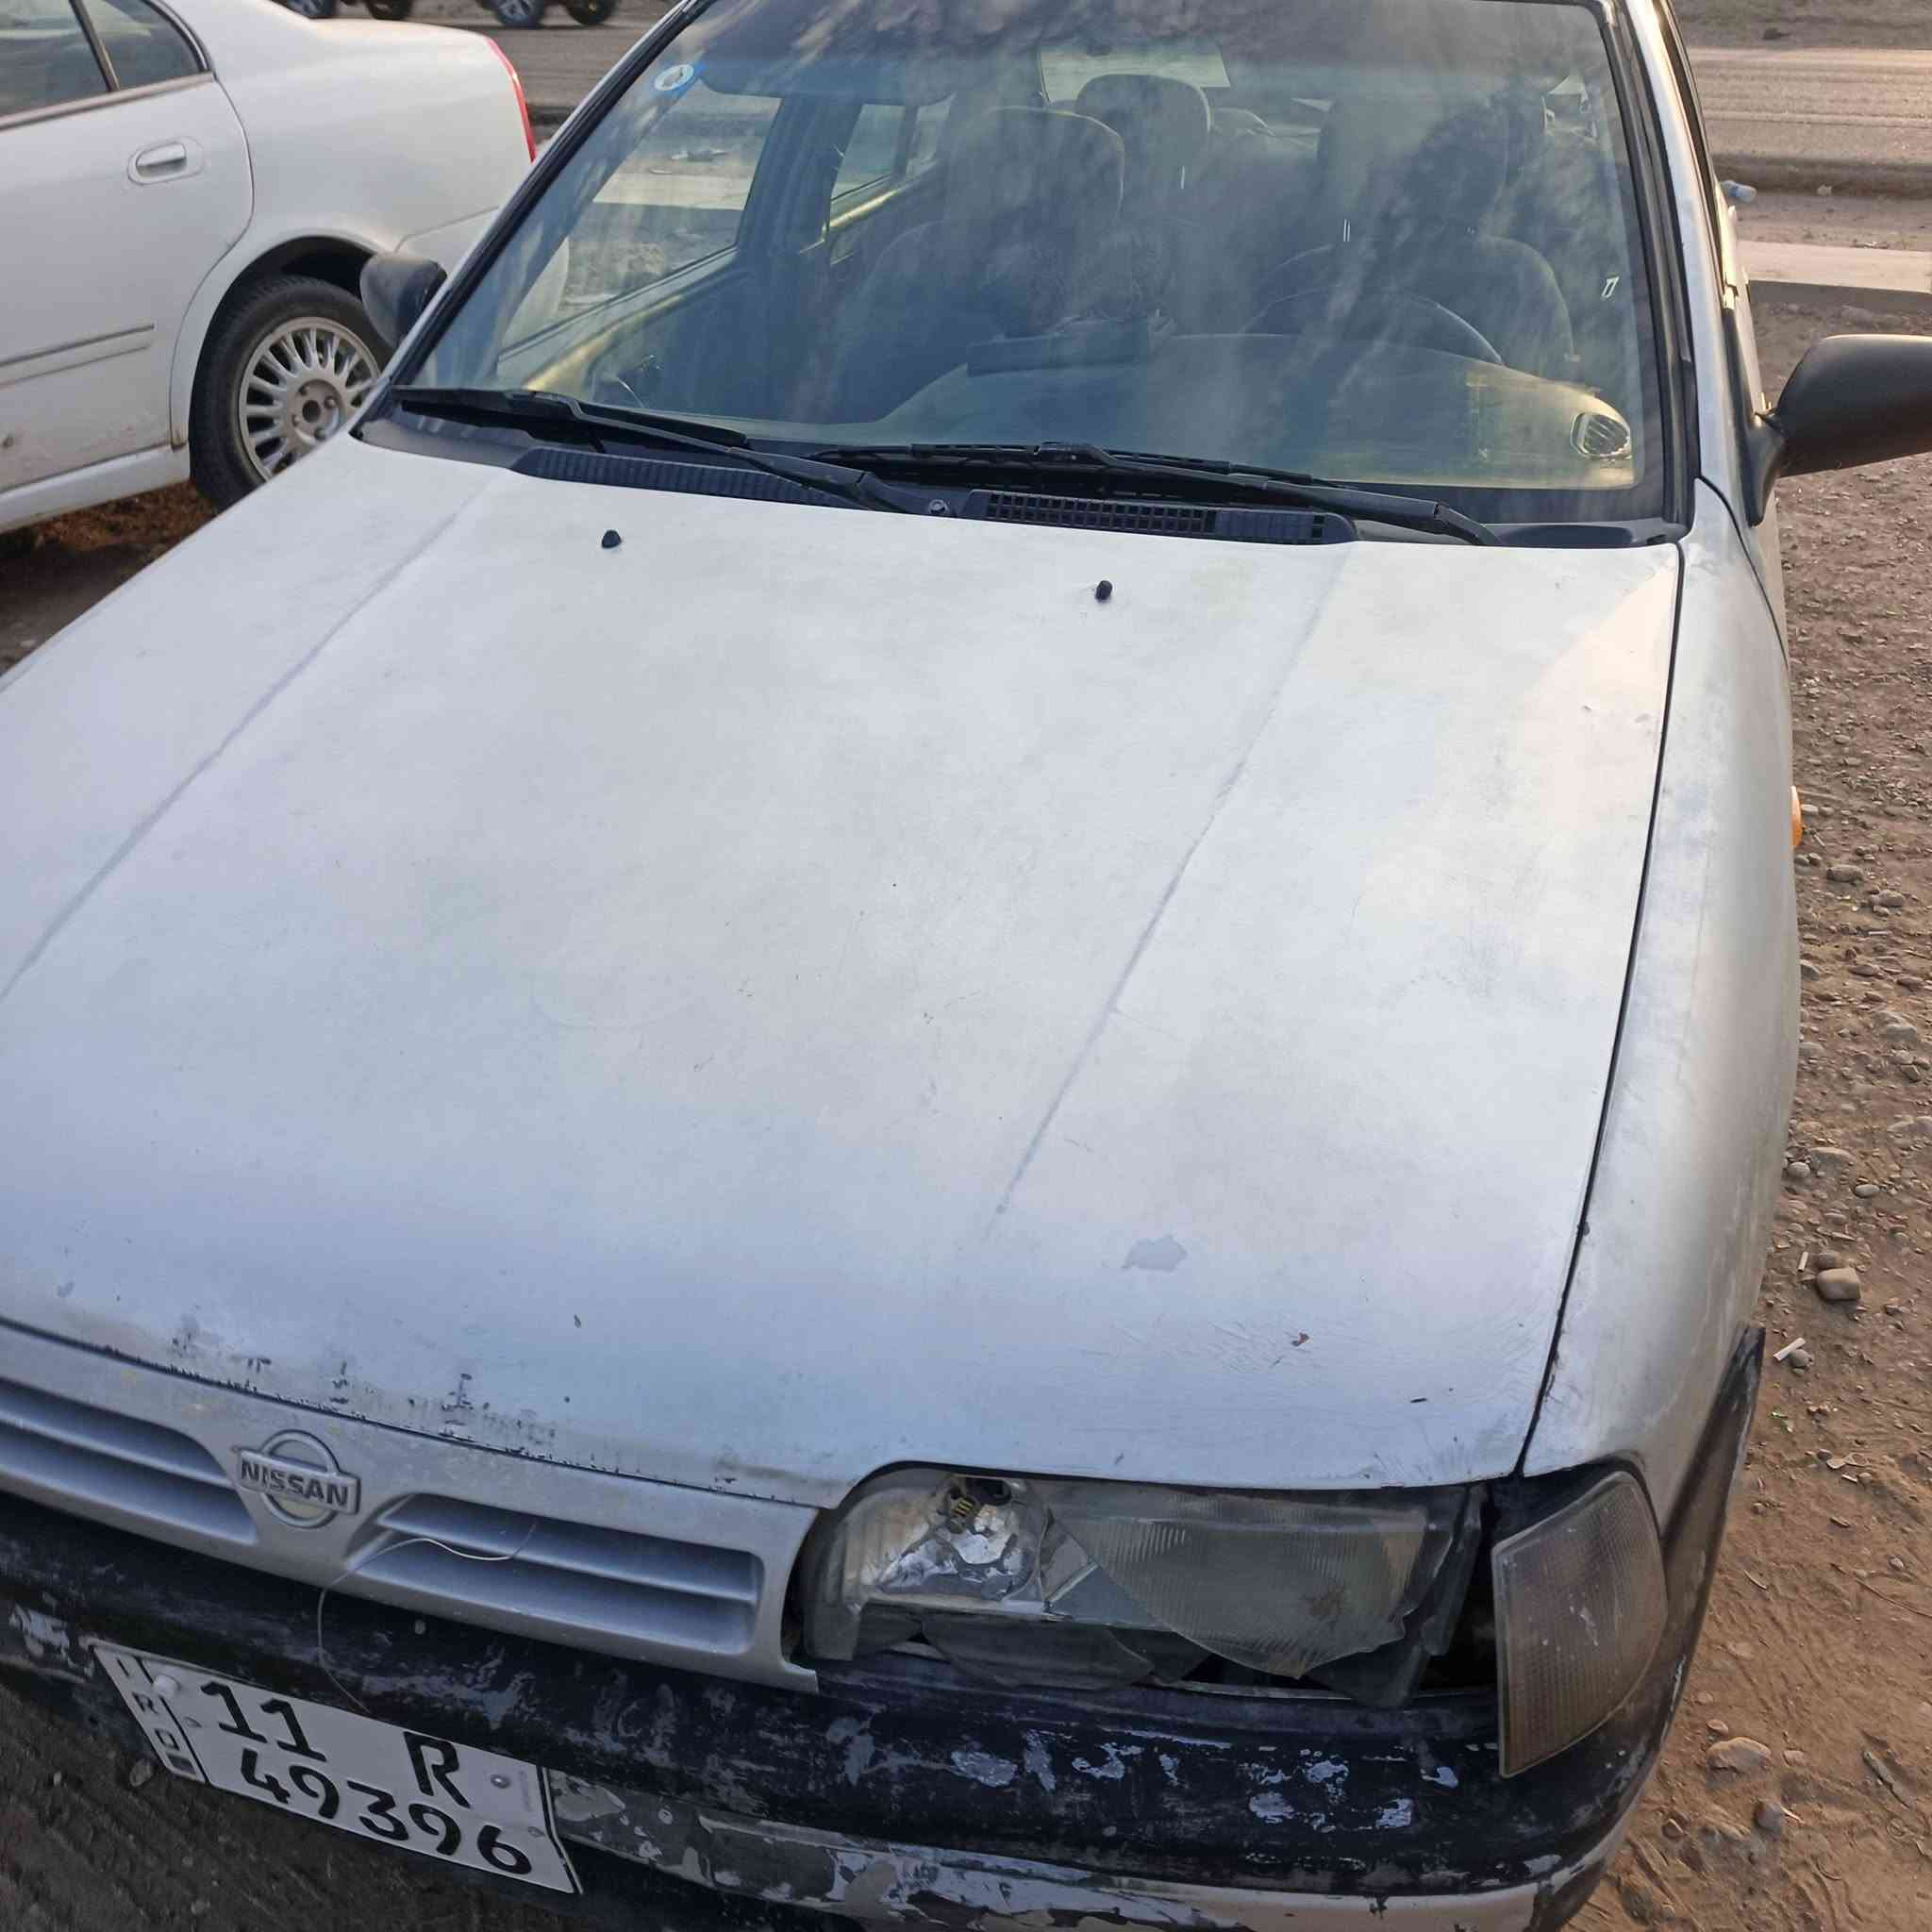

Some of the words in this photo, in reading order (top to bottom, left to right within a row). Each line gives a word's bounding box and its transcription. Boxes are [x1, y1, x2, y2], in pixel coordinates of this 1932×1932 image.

[241, 1458, 349, 1507] NISSAN
[200, 1681, 327, 1762] 11
[403, 1730, 471, 1808] R
[241, 1748, 532, 1875] 49396
